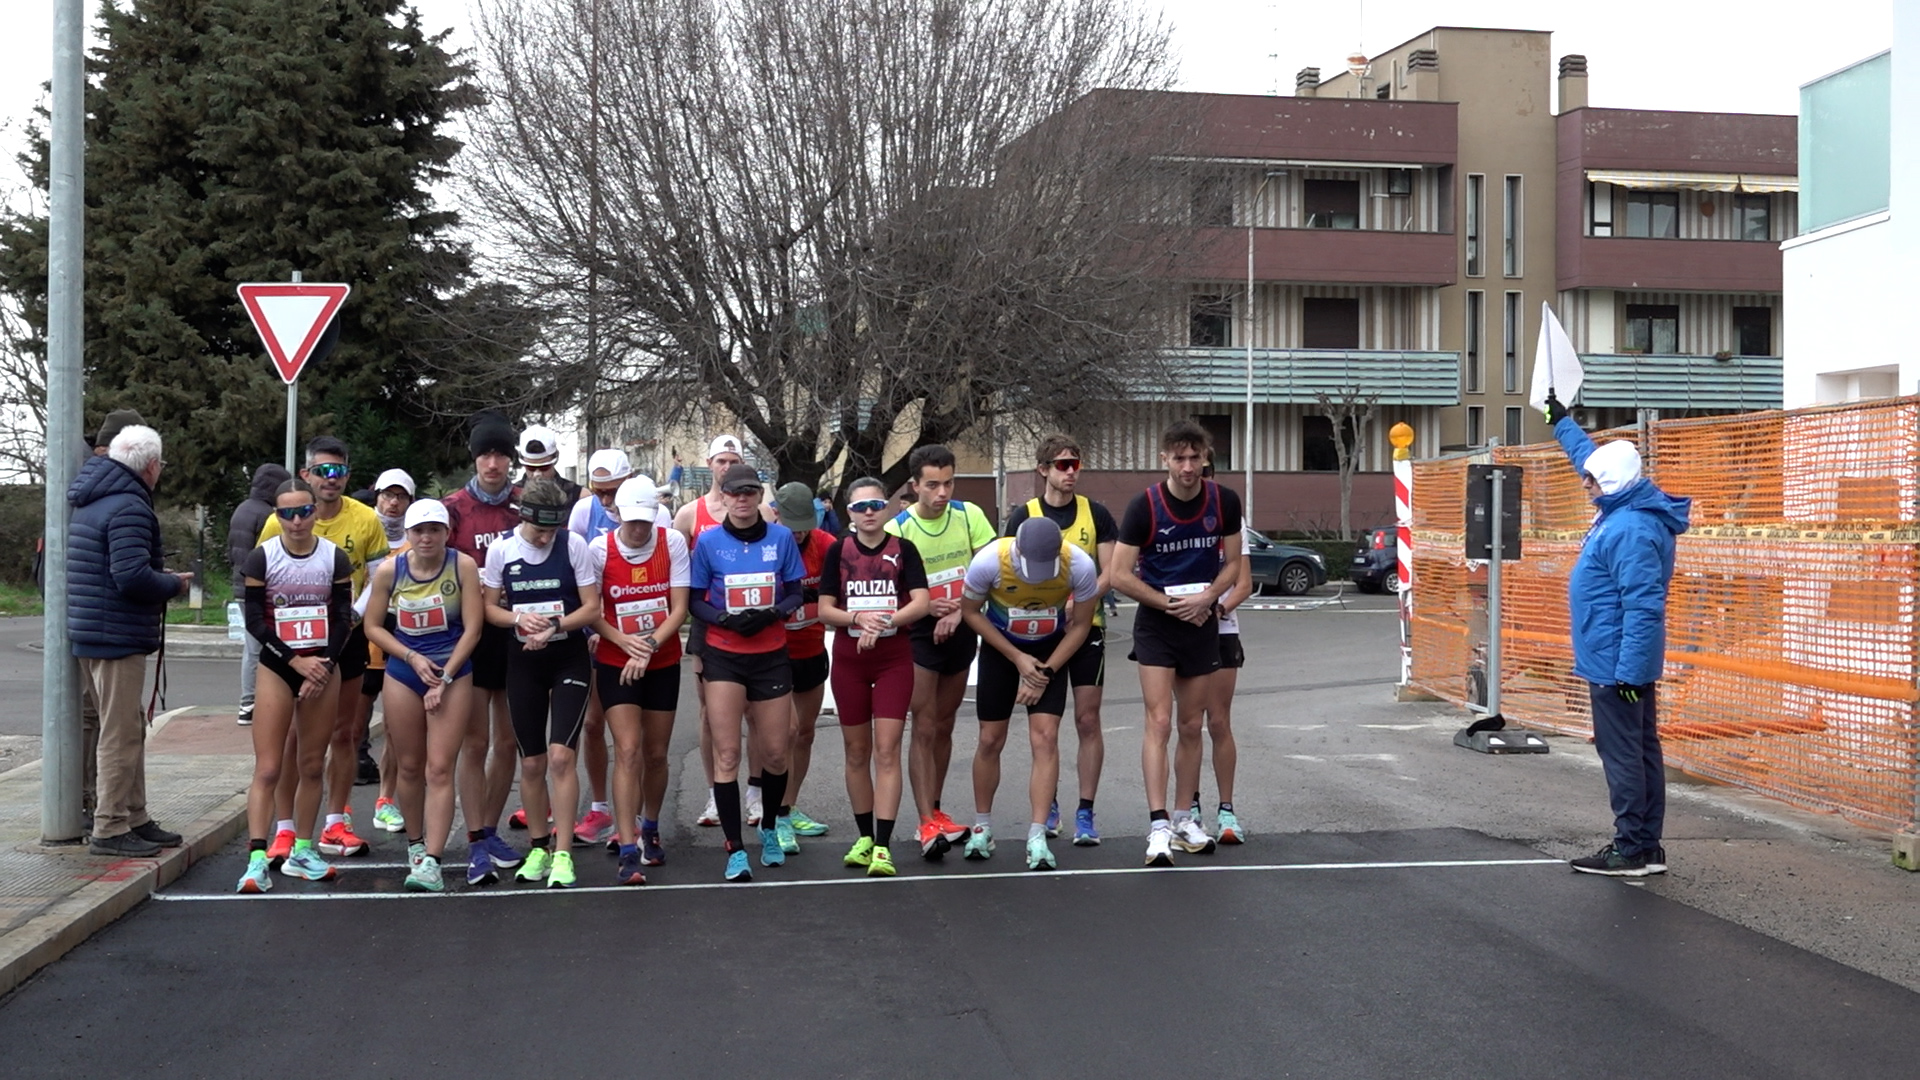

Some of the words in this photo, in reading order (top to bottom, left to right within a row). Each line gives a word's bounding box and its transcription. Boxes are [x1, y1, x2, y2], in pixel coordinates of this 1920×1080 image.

[846, 579, 896, 596] POLIZIA
[741, 587, 761, 606] 18
[411, 612, 429, 628] 17
[634, 614, 655, 631] 13
[1027, 620, 1039, 634] 9
[292, 621, 313, 640] 14
